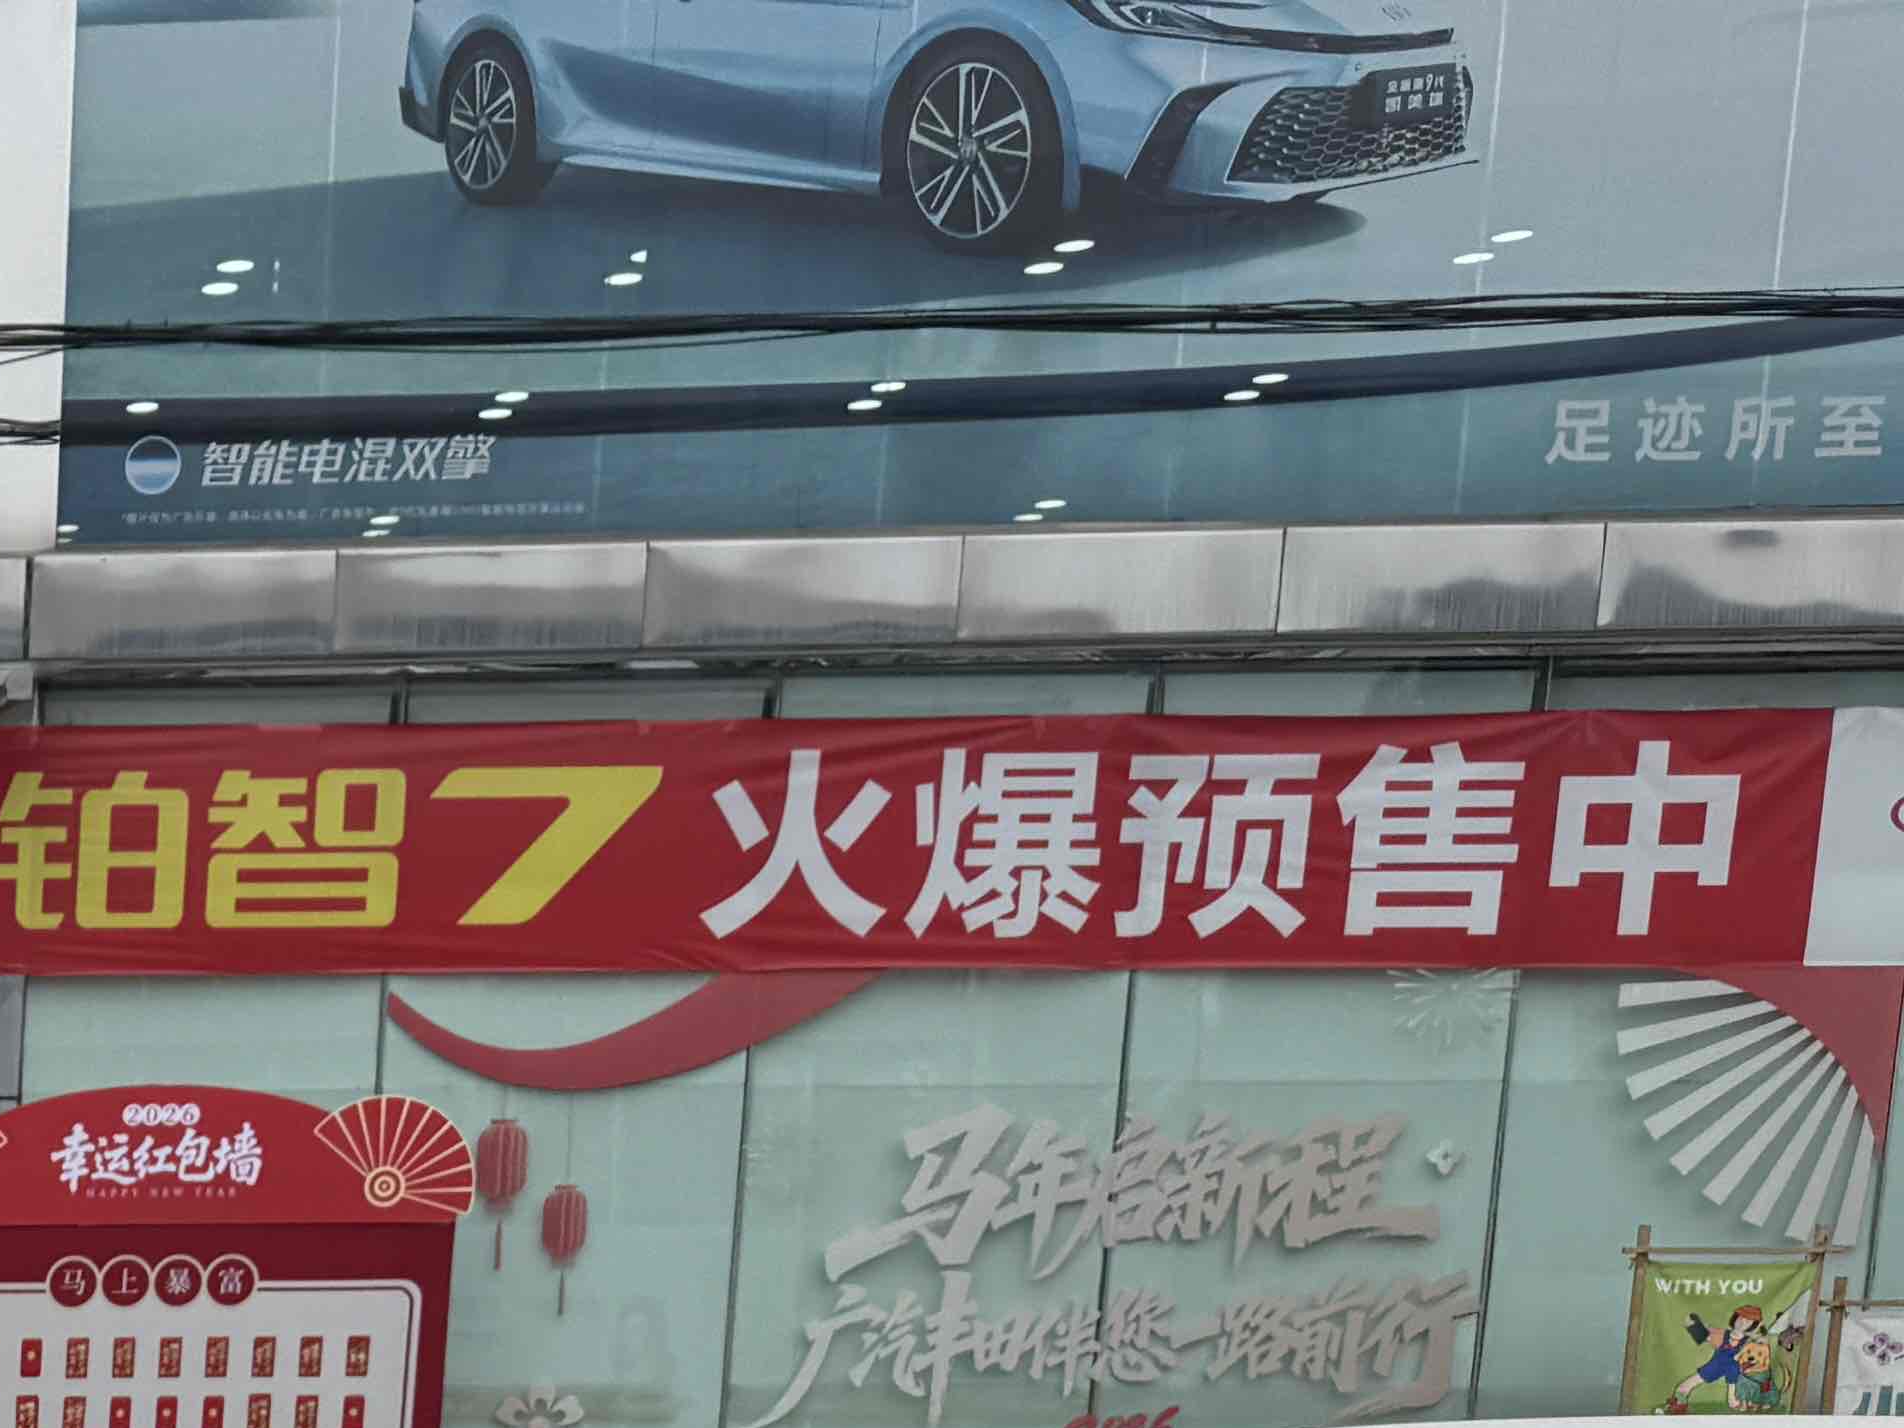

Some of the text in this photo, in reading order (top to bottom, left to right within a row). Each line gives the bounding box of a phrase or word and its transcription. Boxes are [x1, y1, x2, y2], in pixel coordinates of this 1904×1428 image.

[1544, 395, 1887, 465] 足迹所至
[200, 434, 496, 487] 智能电混双擎
[697, 738, 1741, 940] 火爆预售中
[124, 1103, 201, 1126] 2026
[50, 1121, 263, 1194] 幸运红包墙
[86, 1186, 237, 1199] HAPPY NEW YEAR
[825, 1103, 1439, 1284] 马年启新程
[60, 1266, 245, 1296] 马上暴富
[1655, 1278, 1764, 1295] WITH YOU
